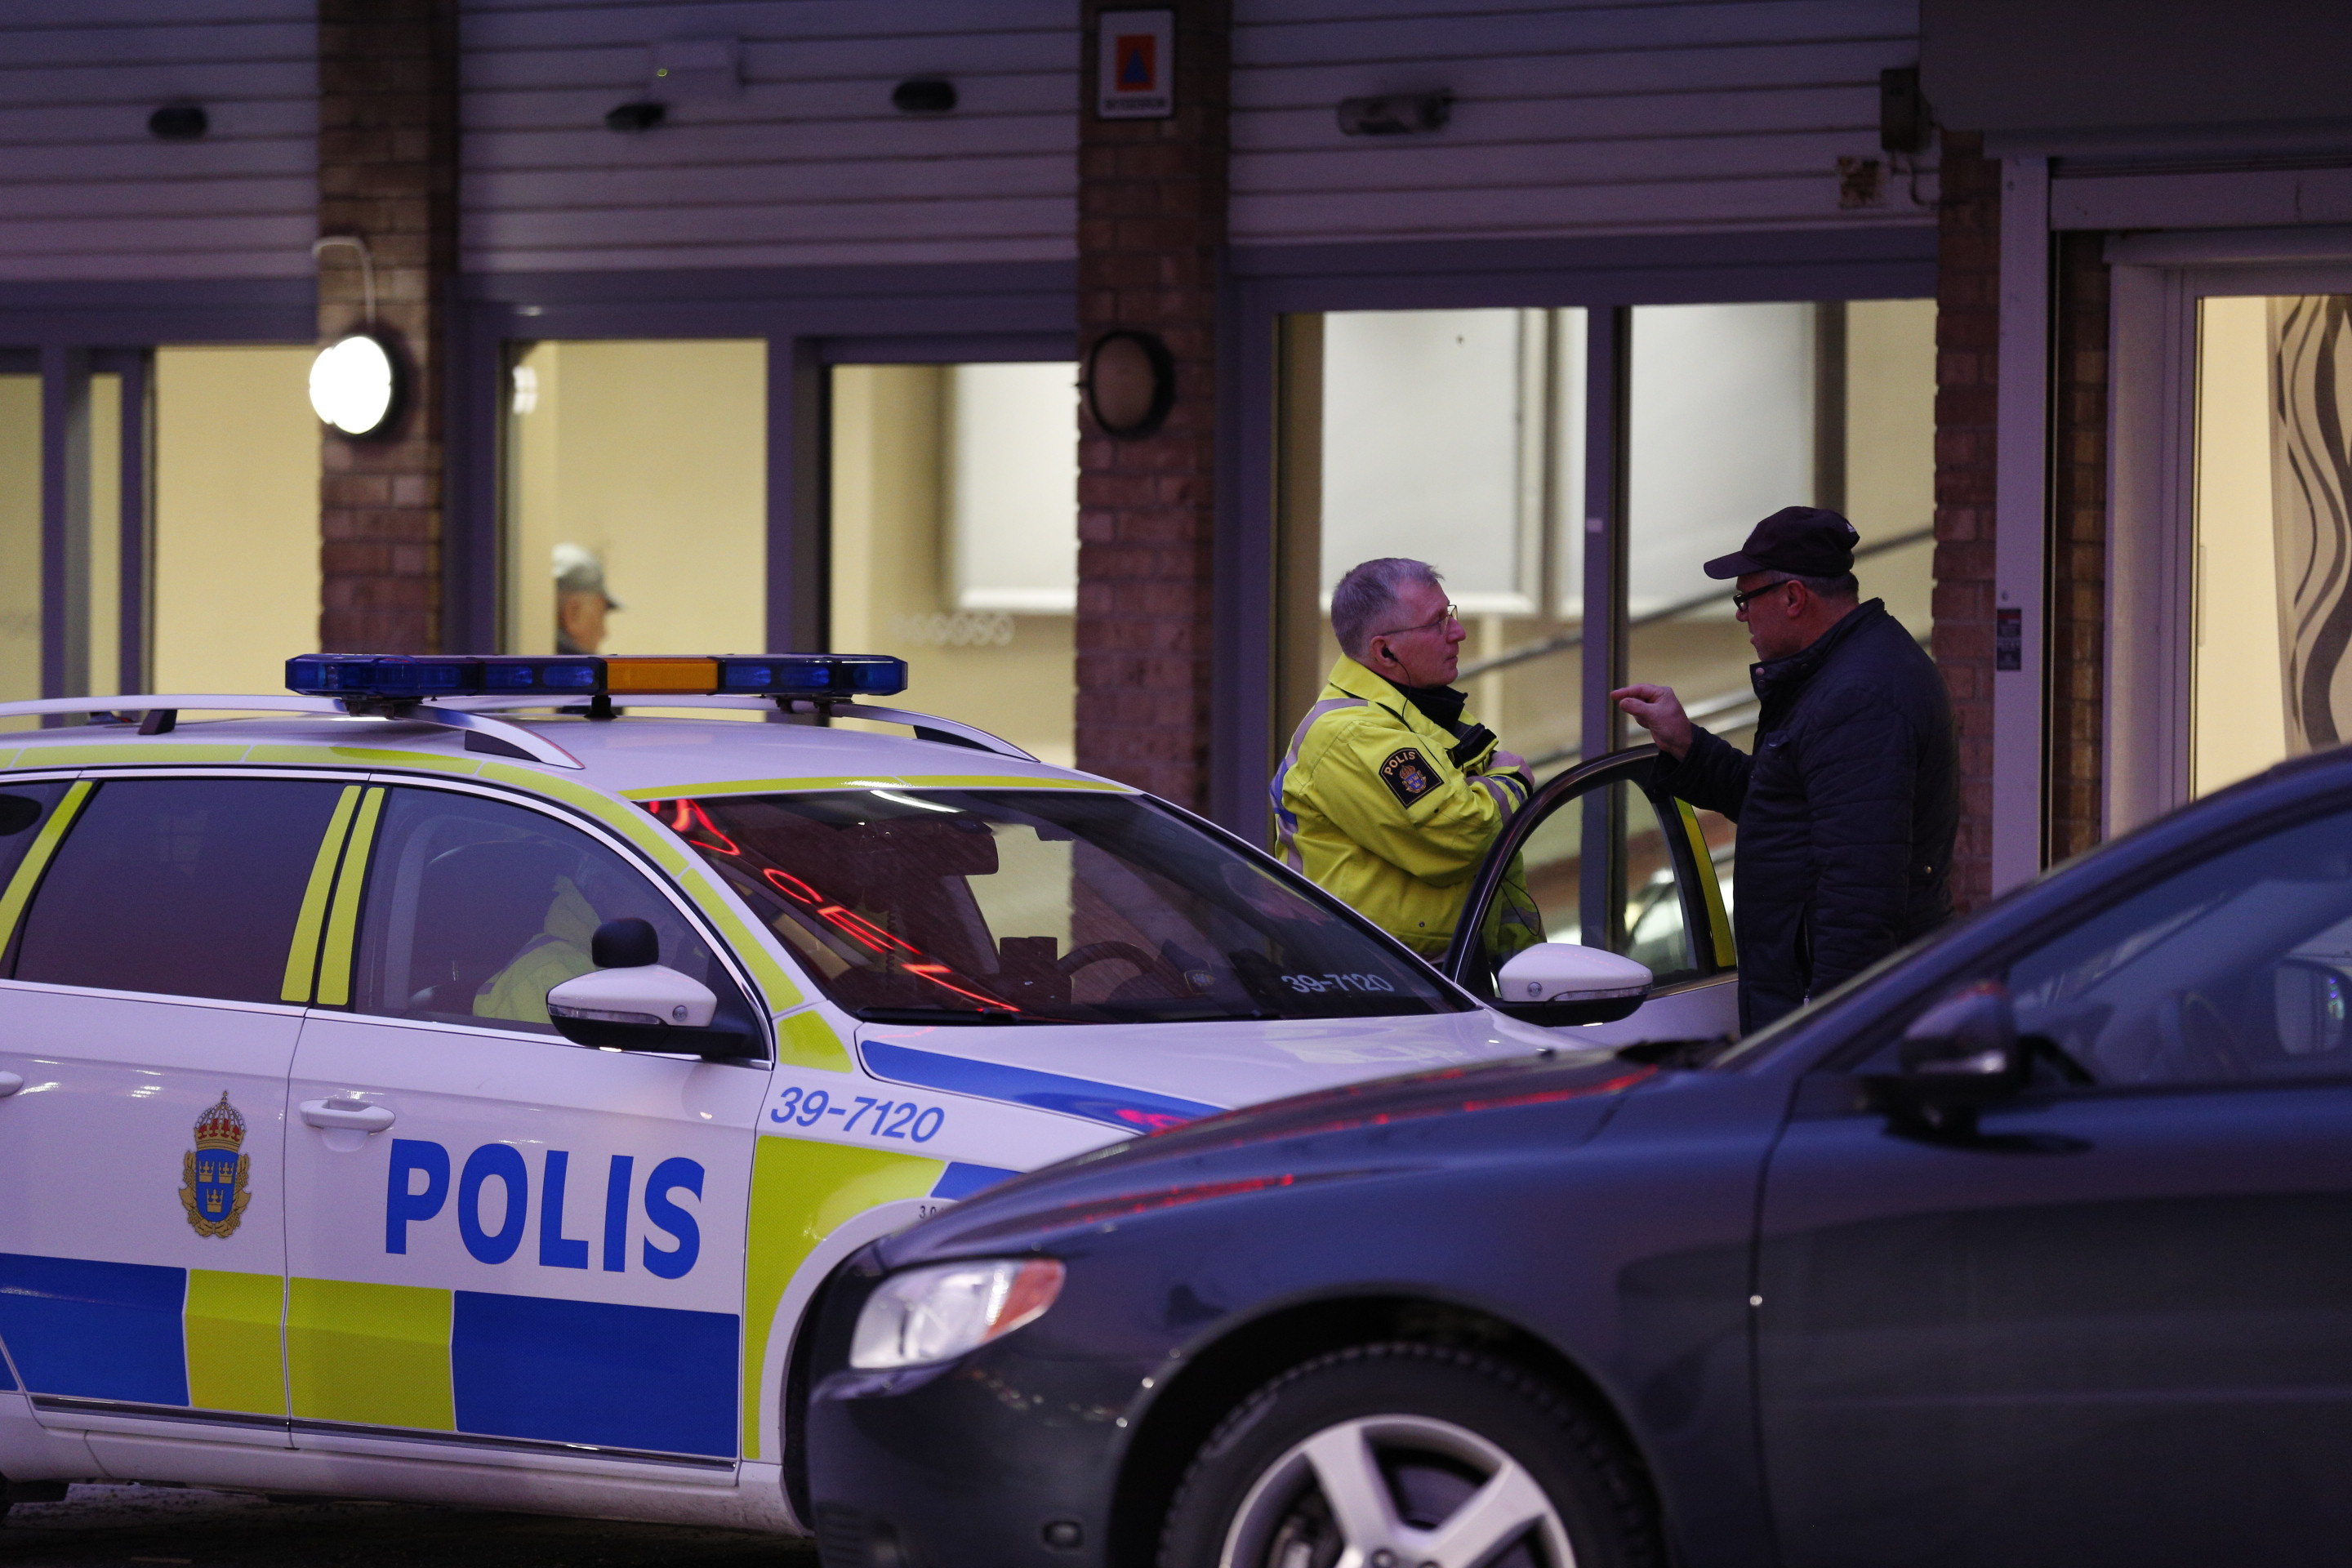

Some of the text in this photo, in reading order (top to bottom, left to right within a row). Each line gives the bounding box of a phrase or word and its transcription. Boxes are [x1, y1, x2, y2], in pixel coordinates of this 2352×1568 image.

[1384, 751, 1416, 776] POLIS
[1281, 973, 1394, 993] 39-7120
[771, 1087, 945, 1143] 39-7120
[386, 1138, 705, 1280] POLIS
